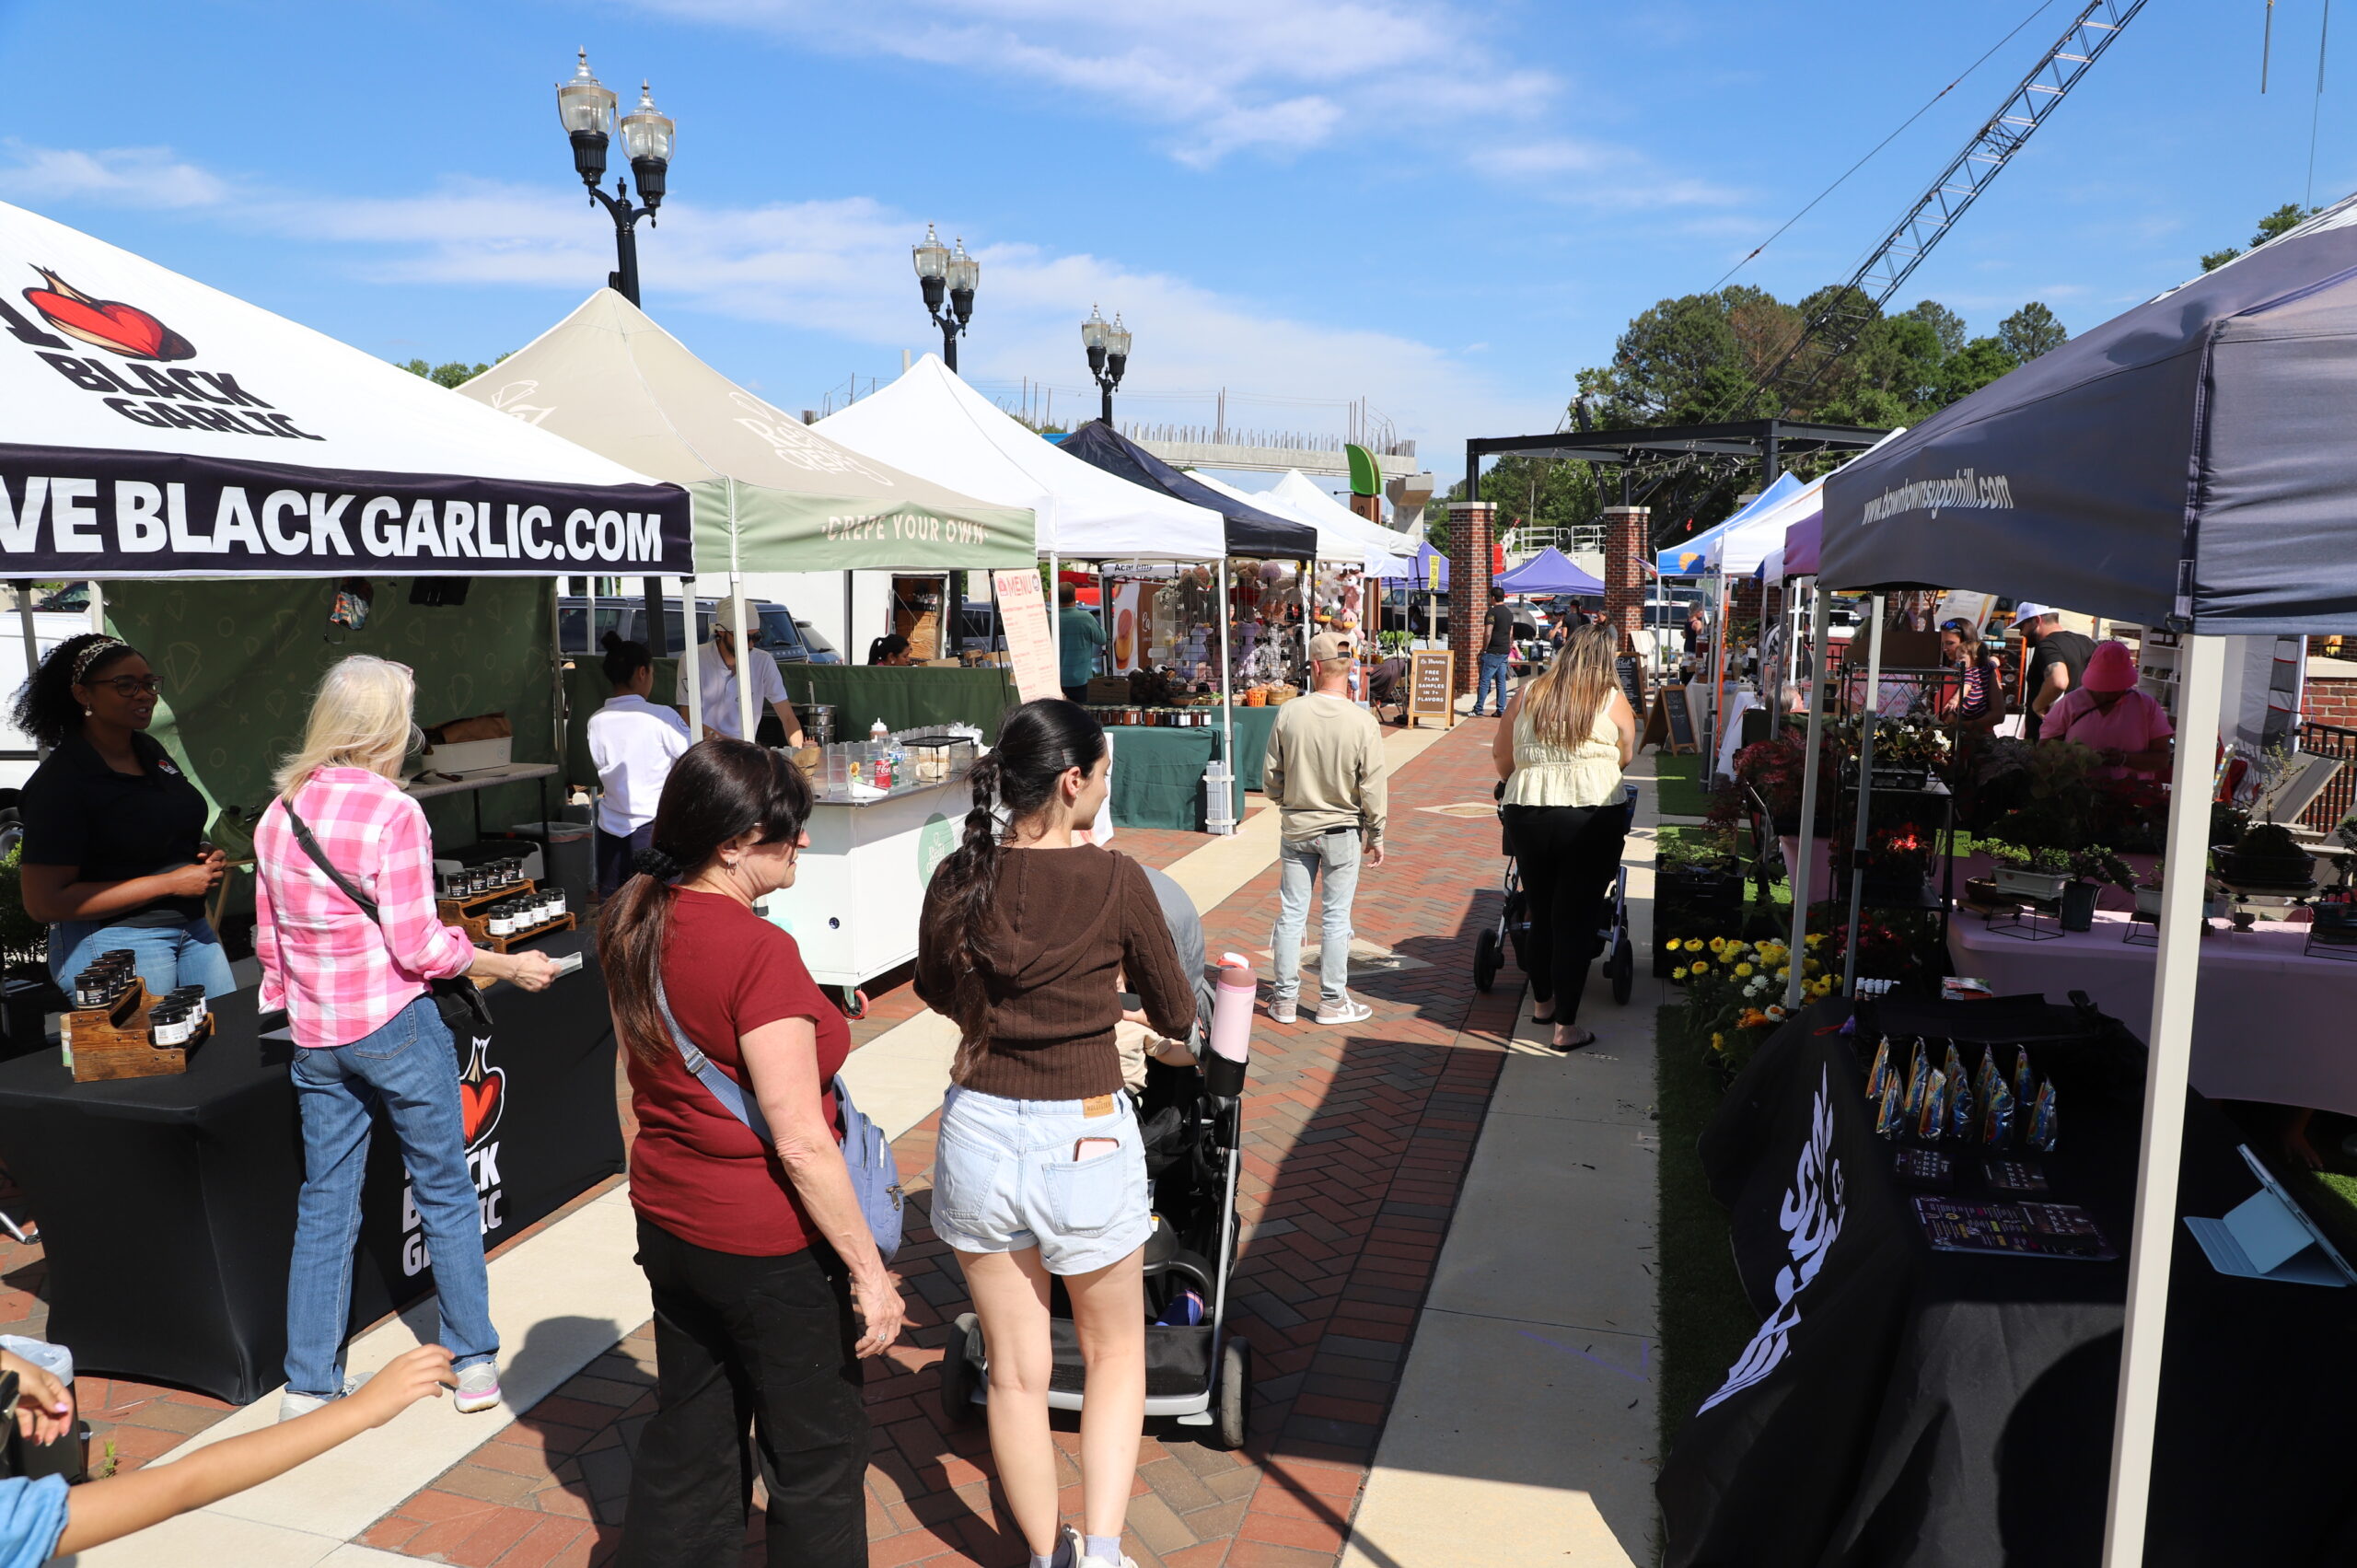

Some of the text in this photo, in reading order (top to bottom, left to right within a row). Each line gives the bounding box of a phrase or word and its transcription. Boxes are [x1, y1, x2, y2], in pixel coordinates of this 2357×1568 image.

[34, 351, 276, 409] BLACK
[102, 398, 327, 441] GARLIC
[1862, 468, 2014, 526] www.downtownsugarhill.com
[826, 514, 987, 545] CREPE YOUR OWN
[1006, 574, 1032, 598] MENU
[1114, 563, 1154, 572] Acaemy
